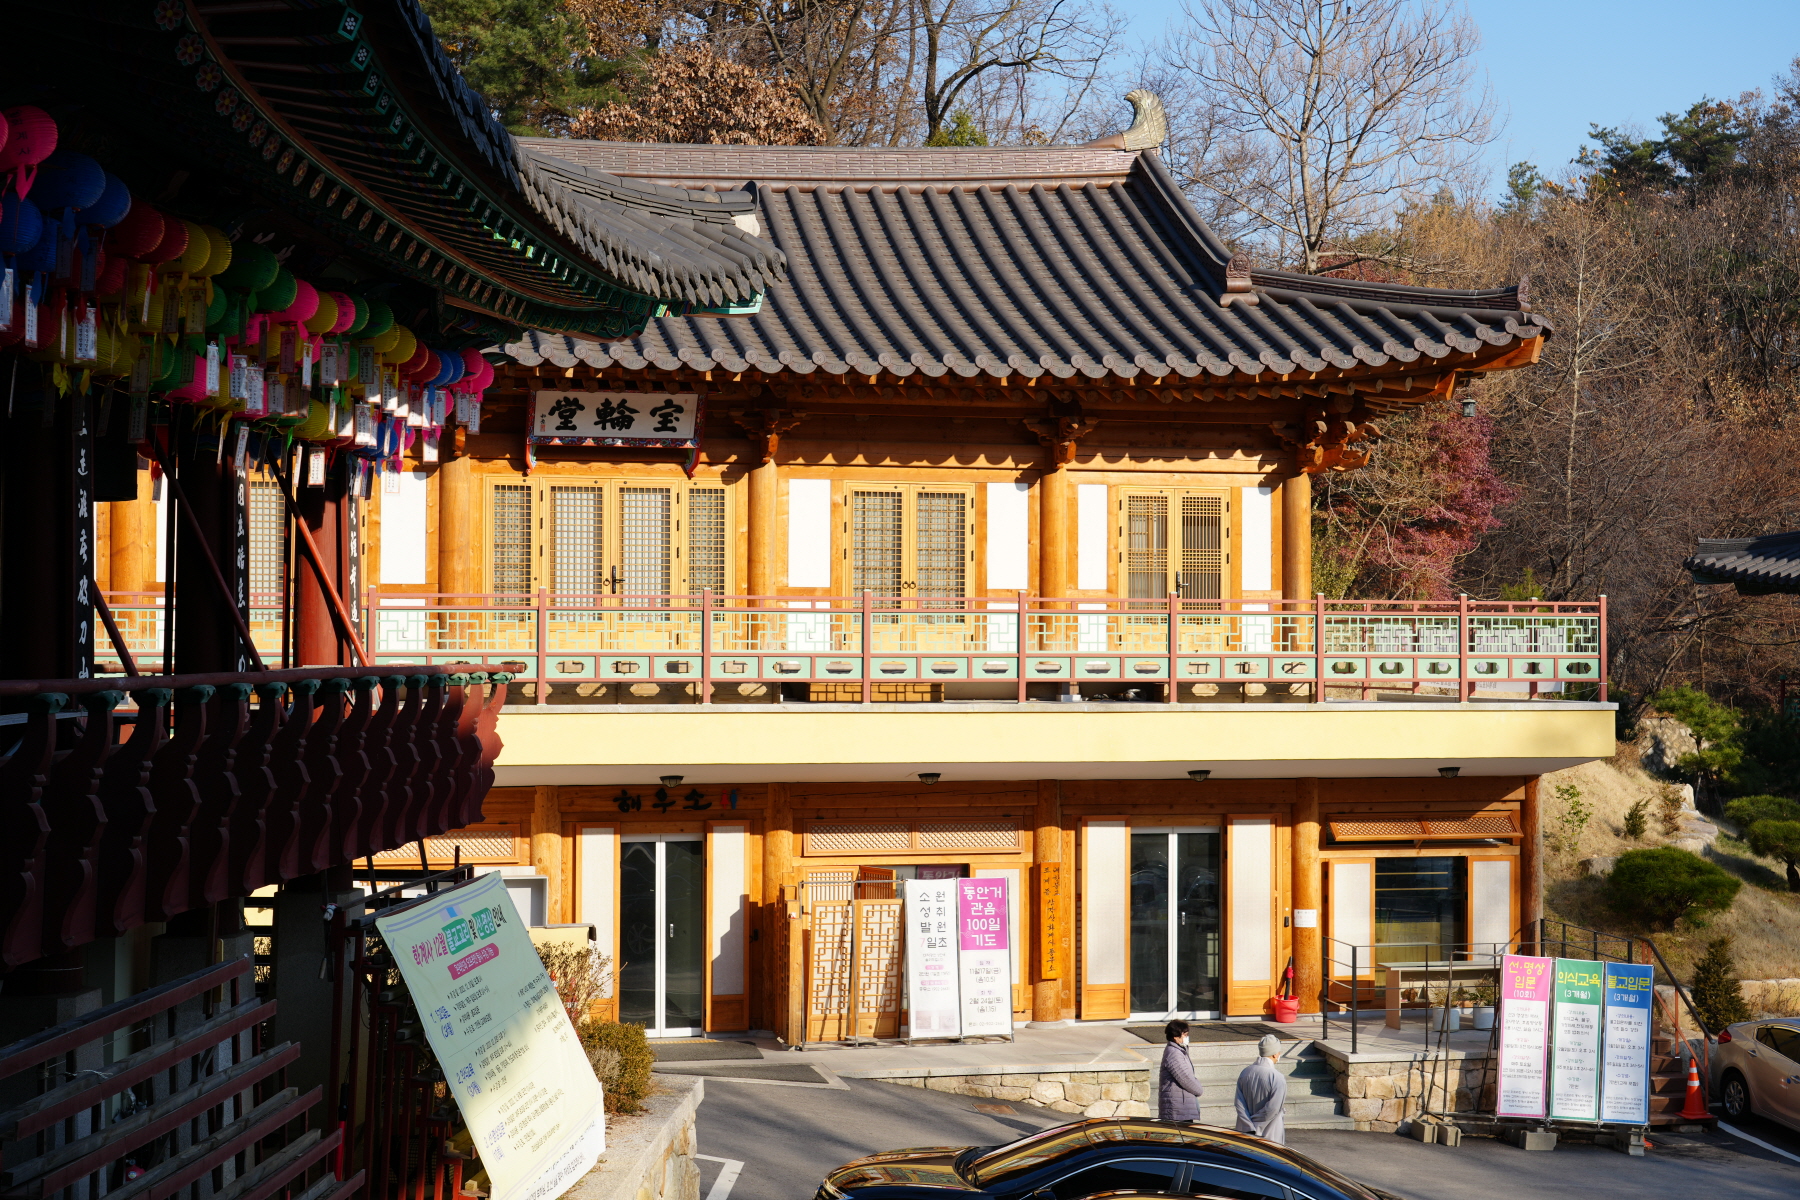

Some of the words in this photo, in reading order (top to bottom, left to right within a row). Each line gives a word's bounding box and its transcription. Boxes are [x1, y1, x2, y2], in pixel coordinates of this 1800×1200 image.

[613, 788, 712, 813] 해우소
[963, 886, 1002, 901] 동안거
[970, 902, 996, 915] 관음
[967, 918, 1001, 931] 100일
[920, 937, 948, 950] 7일초
[971, 934, 997, 947] 기도
[1515, 975, 1536, 989] 입문
[1557, 971, 1601, 988] 의식교육
[1607, 975, 1651, 991] 불교입문
[1513, 989, 1536, 999] (10회)
[1564, 989, 1591, 999] (3개월)
[1613, 993, 1639, 1003] (3개월)
